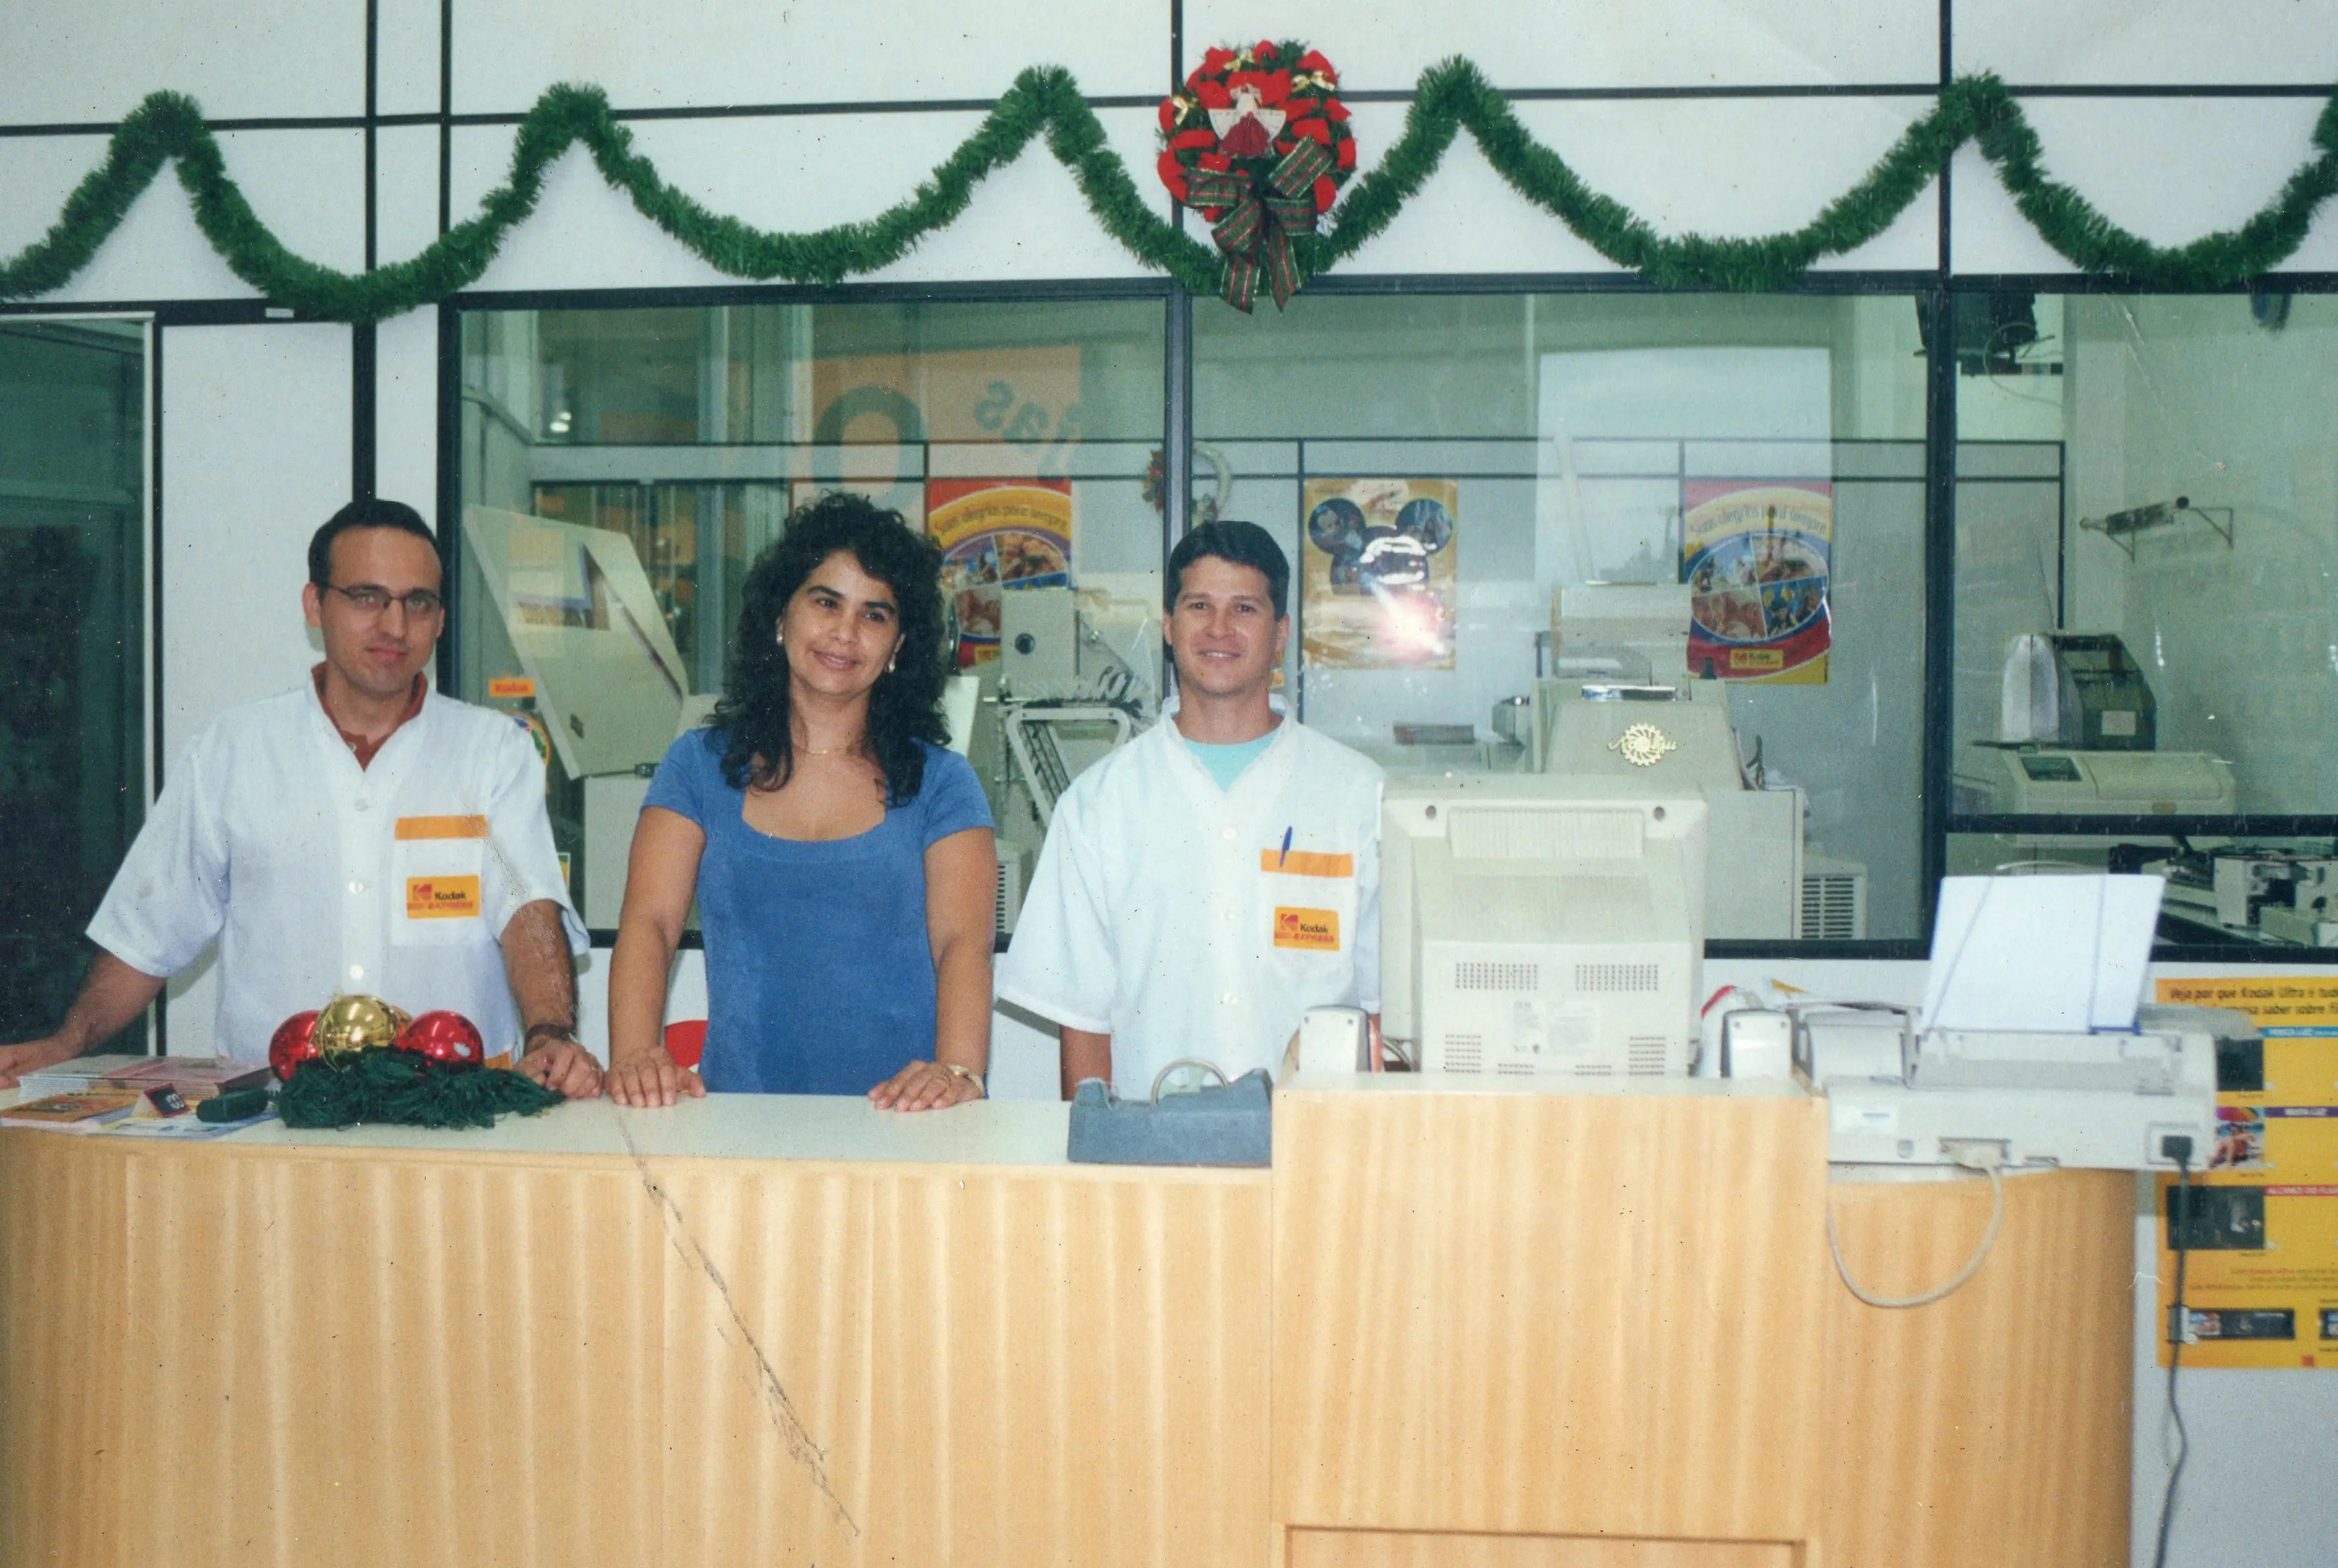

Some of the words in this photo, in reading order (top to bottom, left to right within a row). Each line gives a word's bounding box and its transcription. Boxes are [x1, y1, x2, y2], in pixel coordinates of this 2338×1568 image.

[434, 891, 466, 900] Kodak
[1300, 922, 1328, 933] Kodak
[2195, 989, 2214, 1001] por
[2216, 988, 2237, 1000] que
[2242, 986, 2274, 998] Kodak
[2262, 1002, 2290, 1015] saber
